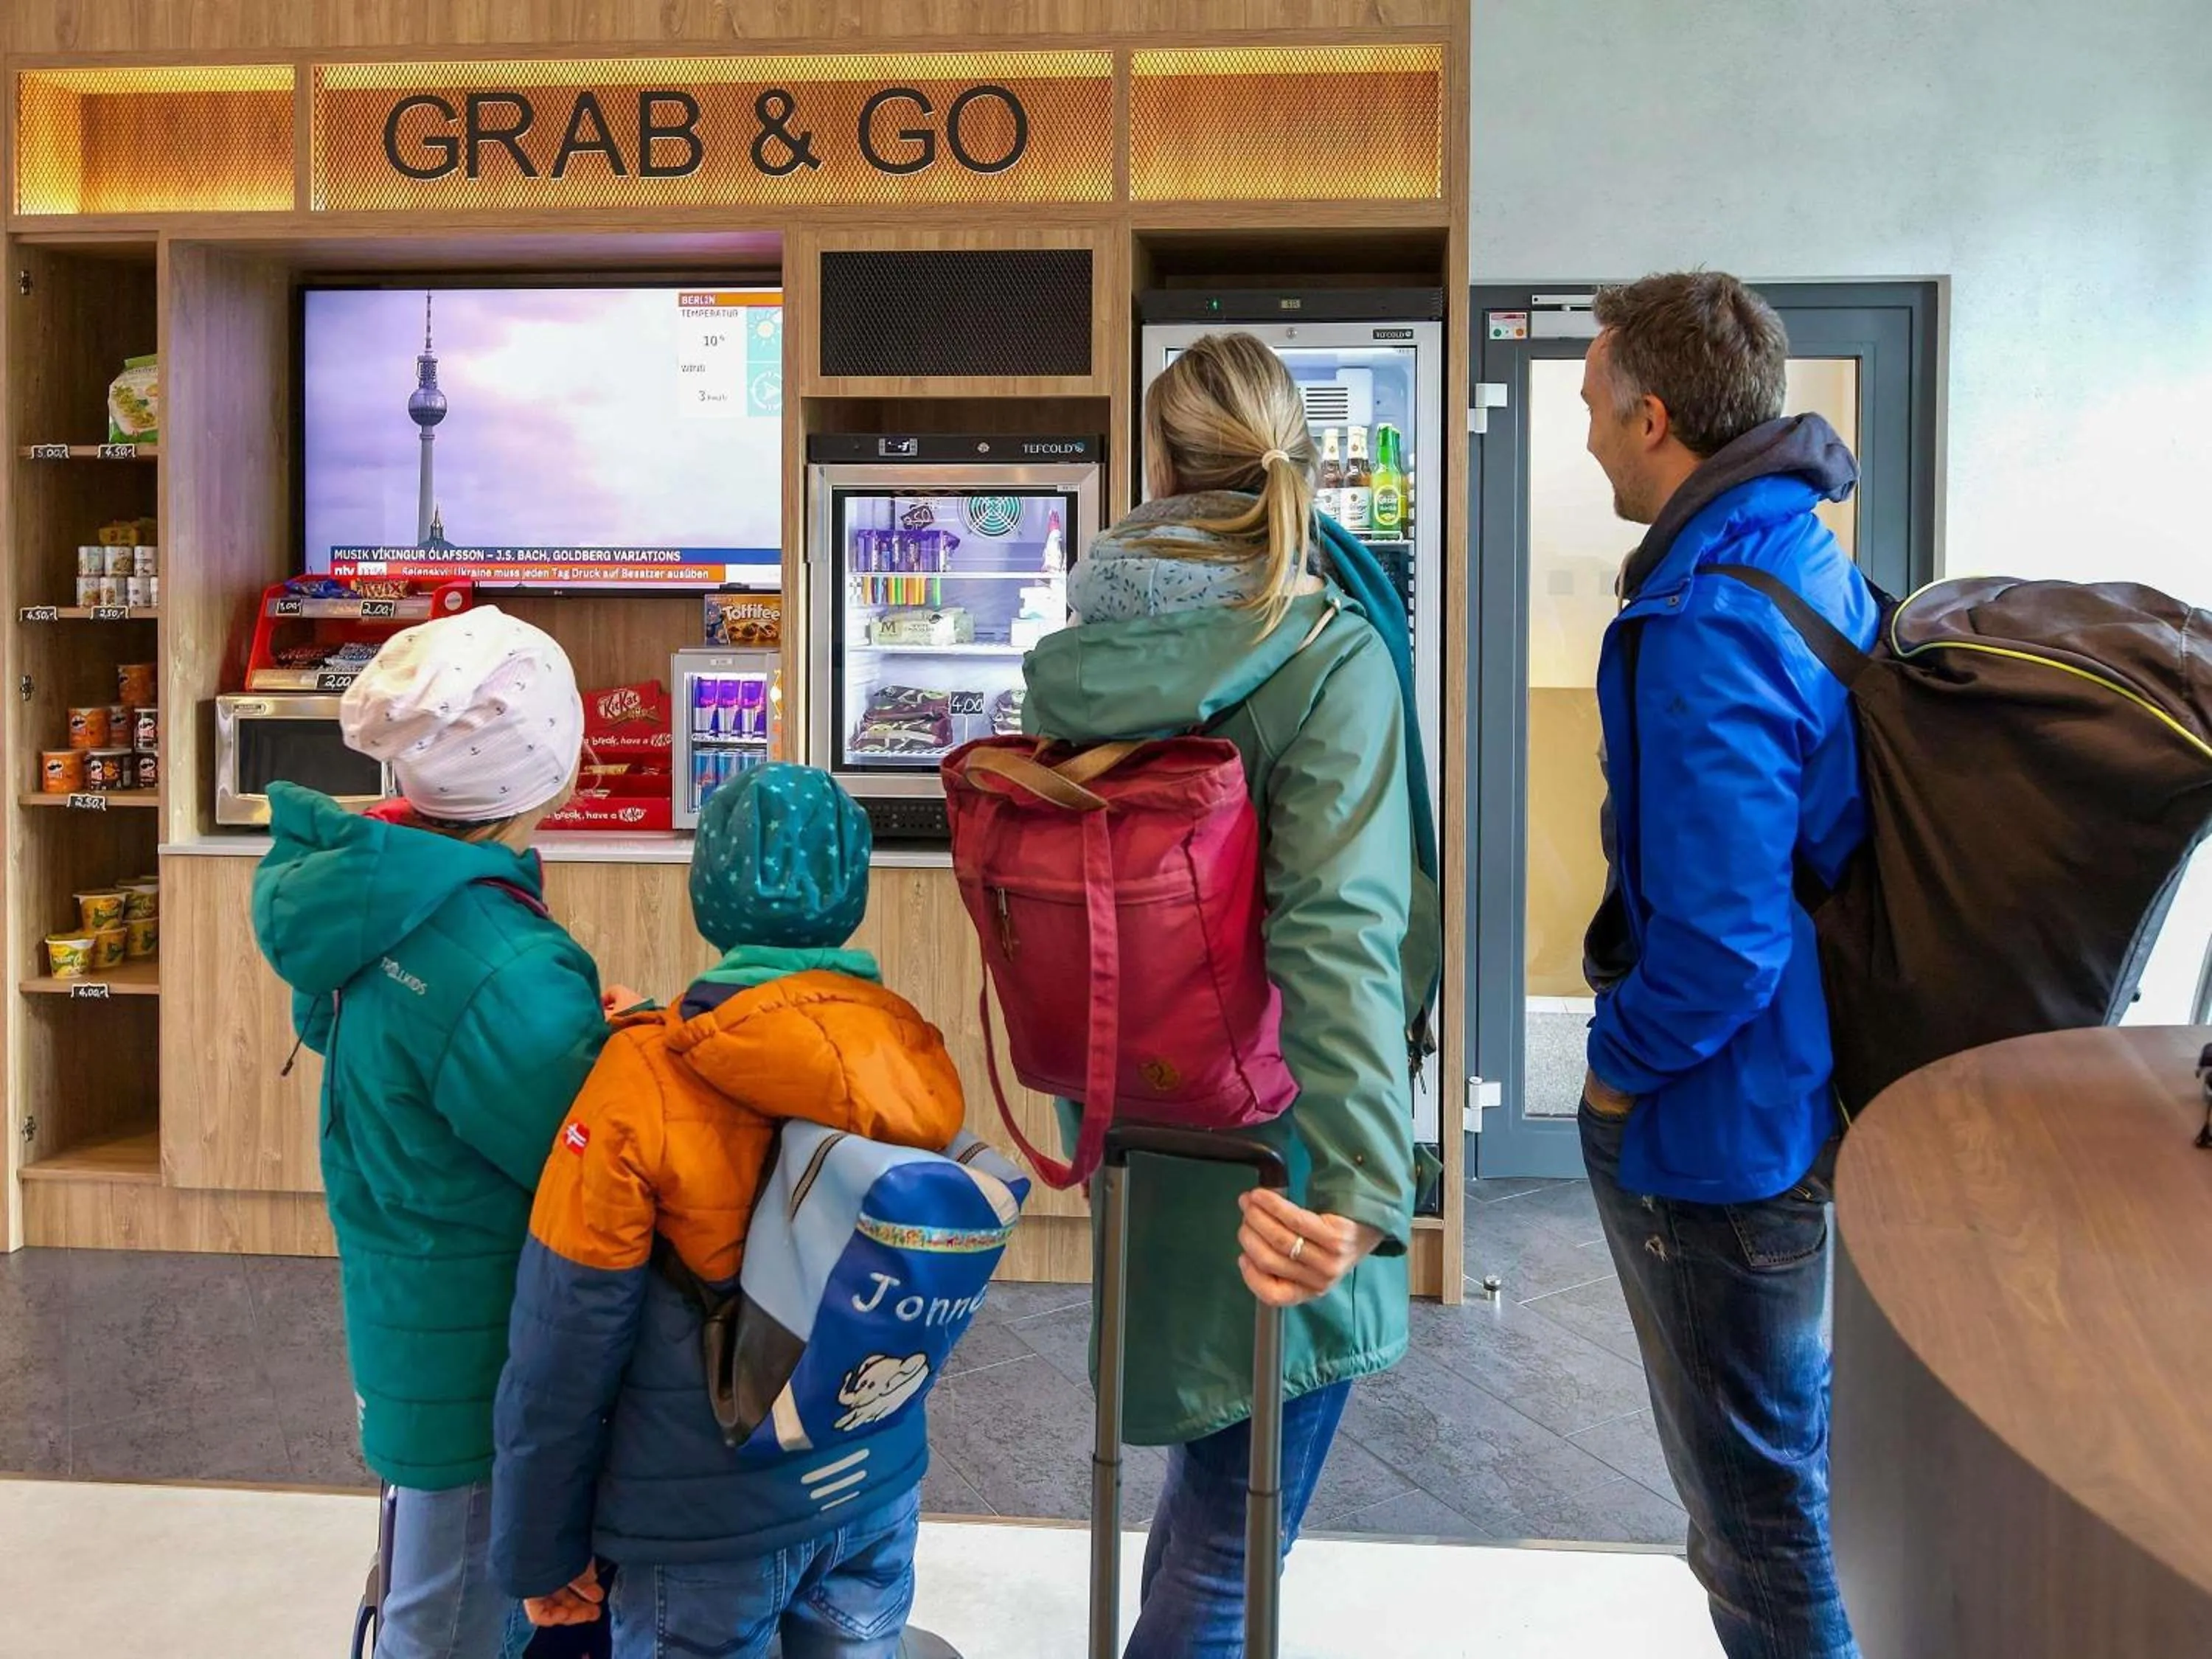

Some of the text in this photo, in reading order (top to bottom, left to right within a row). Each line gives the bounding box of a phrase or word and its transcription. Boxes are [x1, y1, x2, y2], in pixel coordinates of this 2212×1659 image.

[382, 84, 1029, 181] GRAB & GO
[681, 295, 716, 305] BERLIN
[1022, 443, 1073, 453] TEFCOLD
[334, 549, 369, 560] MUSIK
[372, 547, 425, 560] VÍKINGUR
[428, 546, 484, 560] ÓLAFSSON
[495, 549, 515, 560] J.S.
[517, 549, 552, 563] BACH,
[553, 550, 611, 561] GOLDBERG
[613, 550, 681, 562] VARIATIONS
[552, 567, 569, 580] Tag
[571, 568, 600, 578] Druck
[603, 568, 619, 578] auf
[667, 567, 709, 579] ausüben
[723, 603, 780, 620] Toffifee
[601, 691, 639, 717] KitKat
[592, 736, 619, 746] break,
[554, 810, 585, 821] break,
[586, 811, 609, 820] have
